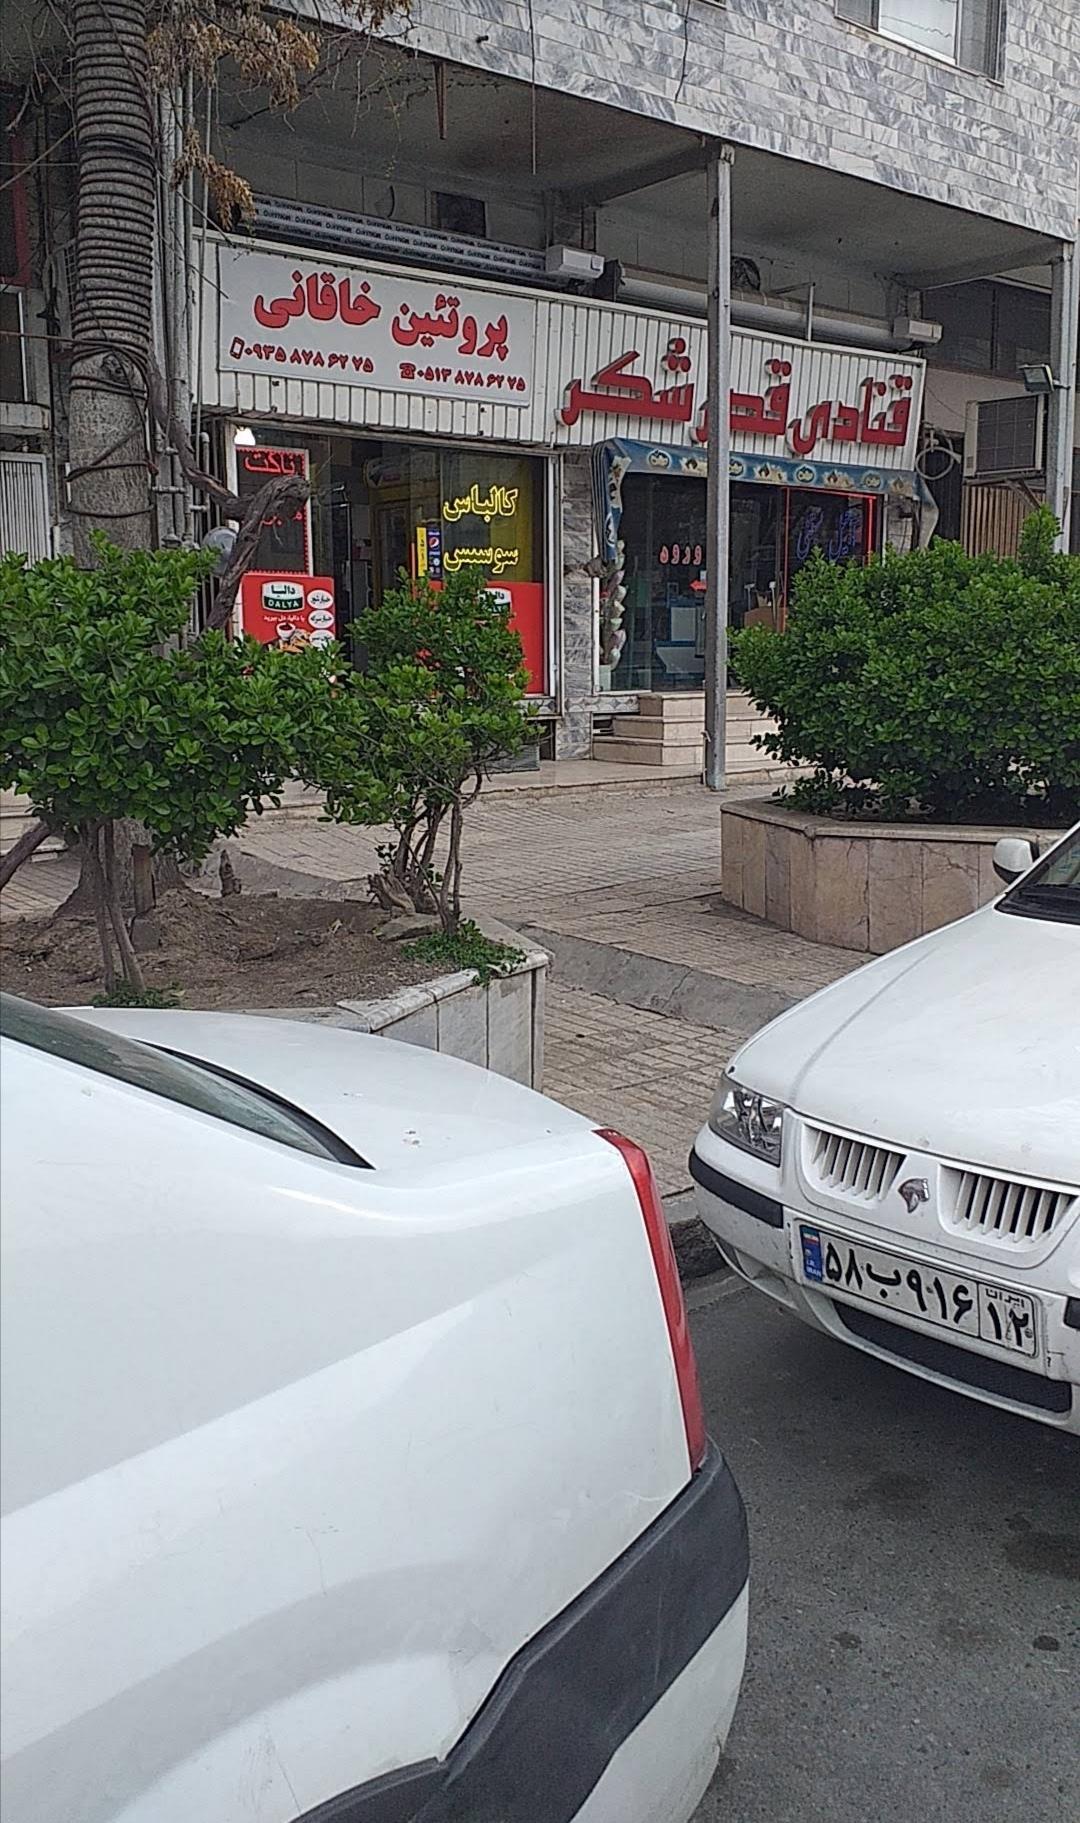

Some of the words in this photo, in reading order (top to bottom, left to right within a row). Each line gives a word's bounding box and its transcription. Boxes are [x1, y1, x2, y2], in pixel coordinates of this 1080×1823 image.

[253, 270, 382, 329] خاقانی
[391, 294, 510, 361] پروتئین
[244, 342, 287, 362] ۰۹۳۵
[290, 347, 325, 367] ۸۷۸
[352, 355, 374, 373] ۷۵
[454, 369, 484, 387] ۸۷۸
[507, 374, 526, 392] ۷۵
[555, 337, 695, 427] شکر
[787, 373, 913, 455] قنادی
[443, 484, 518, 523] کالباس
[268, 599, 299, 609] DALYA
[987, 1301, 1029, 1347] ۱۲
